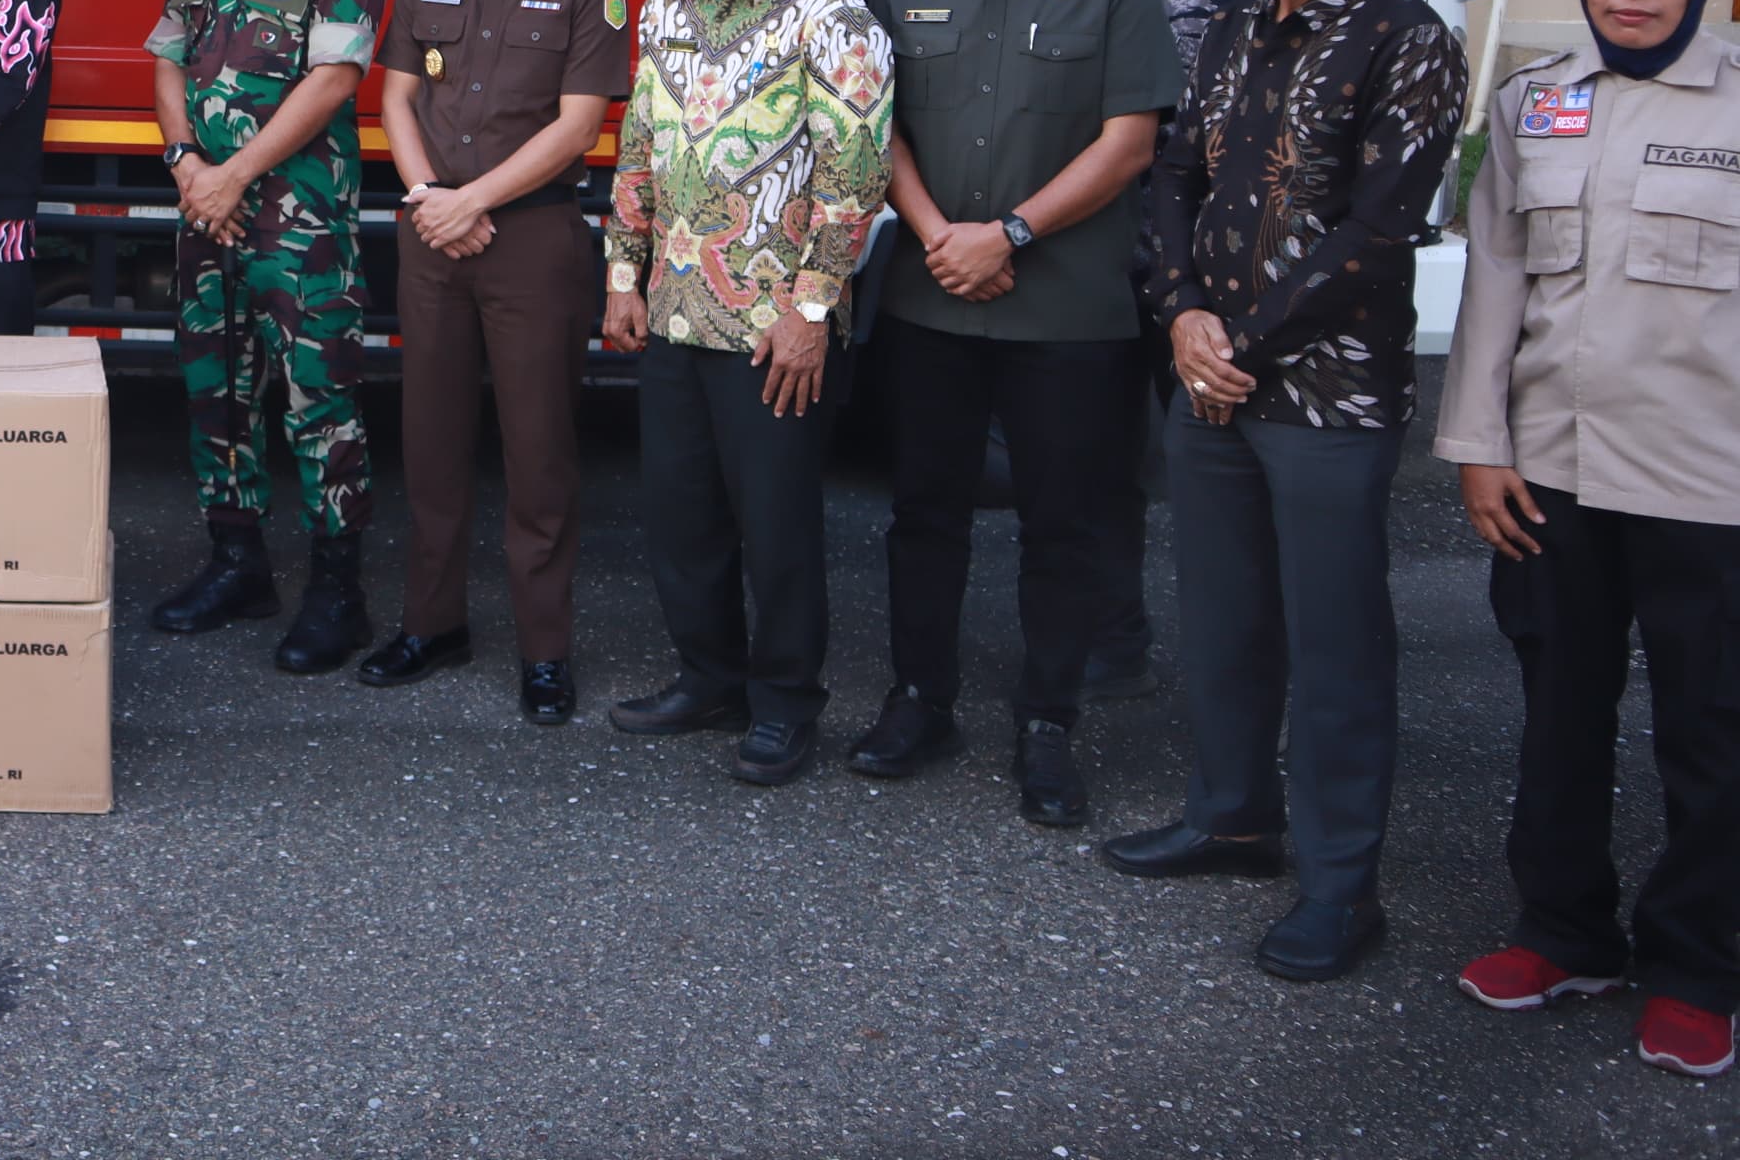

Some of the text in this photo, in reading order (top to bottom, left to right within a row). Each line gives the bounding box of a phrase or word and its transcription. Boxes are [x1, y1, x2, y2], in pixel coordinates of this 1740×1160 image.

[1555, 115, 1587, 129] RESCUE
[1653, 148, 1740, 169] TAGANA
[4, 561, 19, 570] RI
[8, 770, 22, 780] RI
